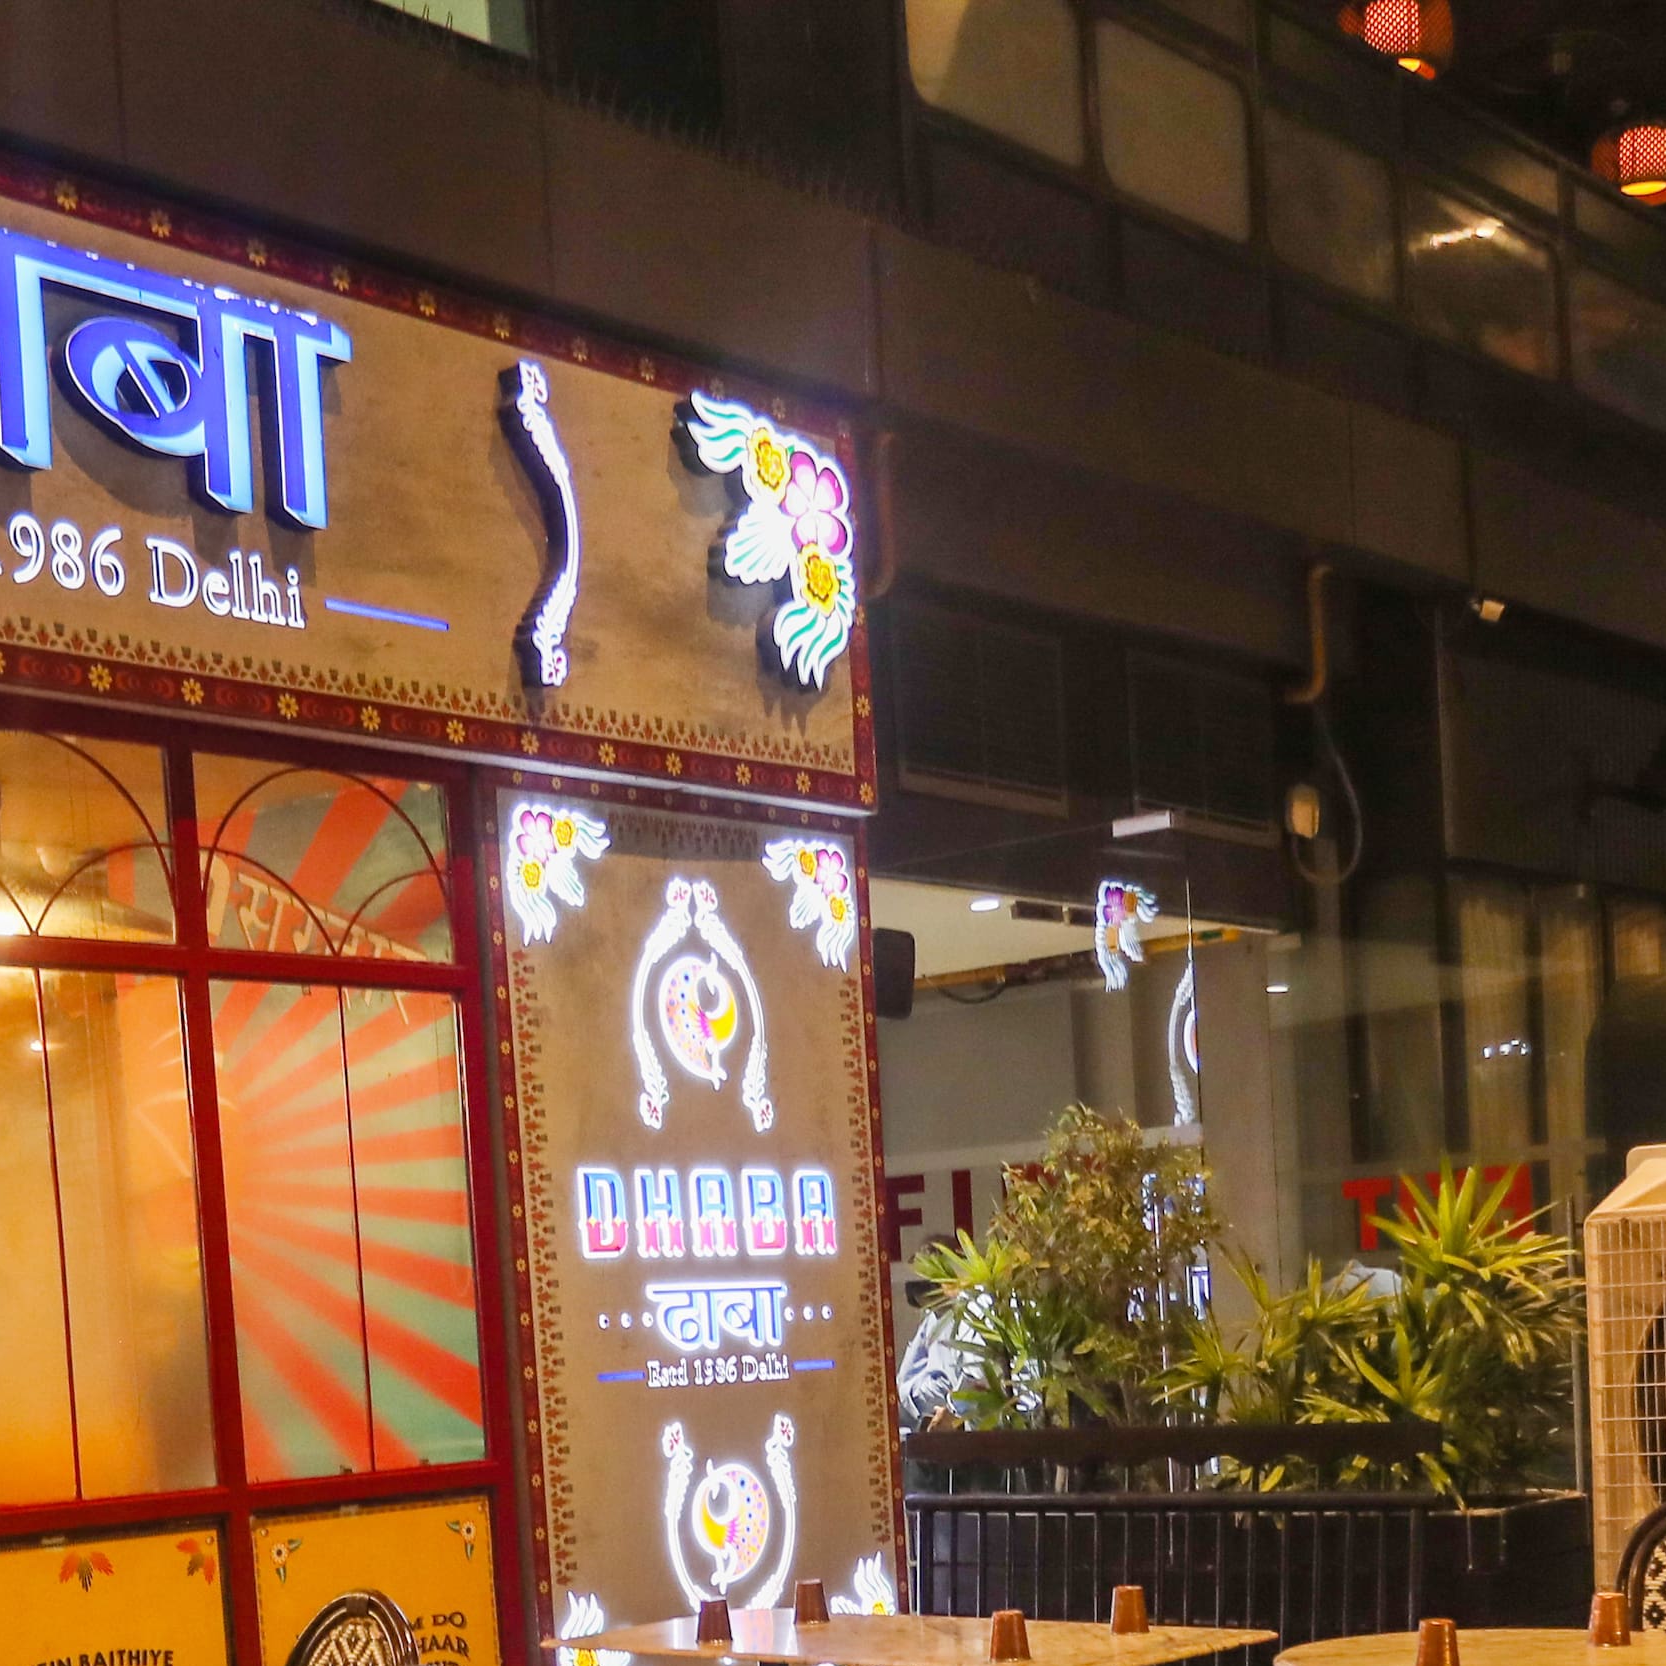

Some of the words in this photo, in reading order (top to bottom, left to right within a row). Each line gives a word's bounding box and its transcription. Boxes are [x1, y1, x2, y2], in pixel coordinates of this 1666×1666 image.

[145, 536, 308, 630] Delhi
[577, 1166, 838, 1259] DHABA
[645, 1281, 788, 1351] ढाबा
